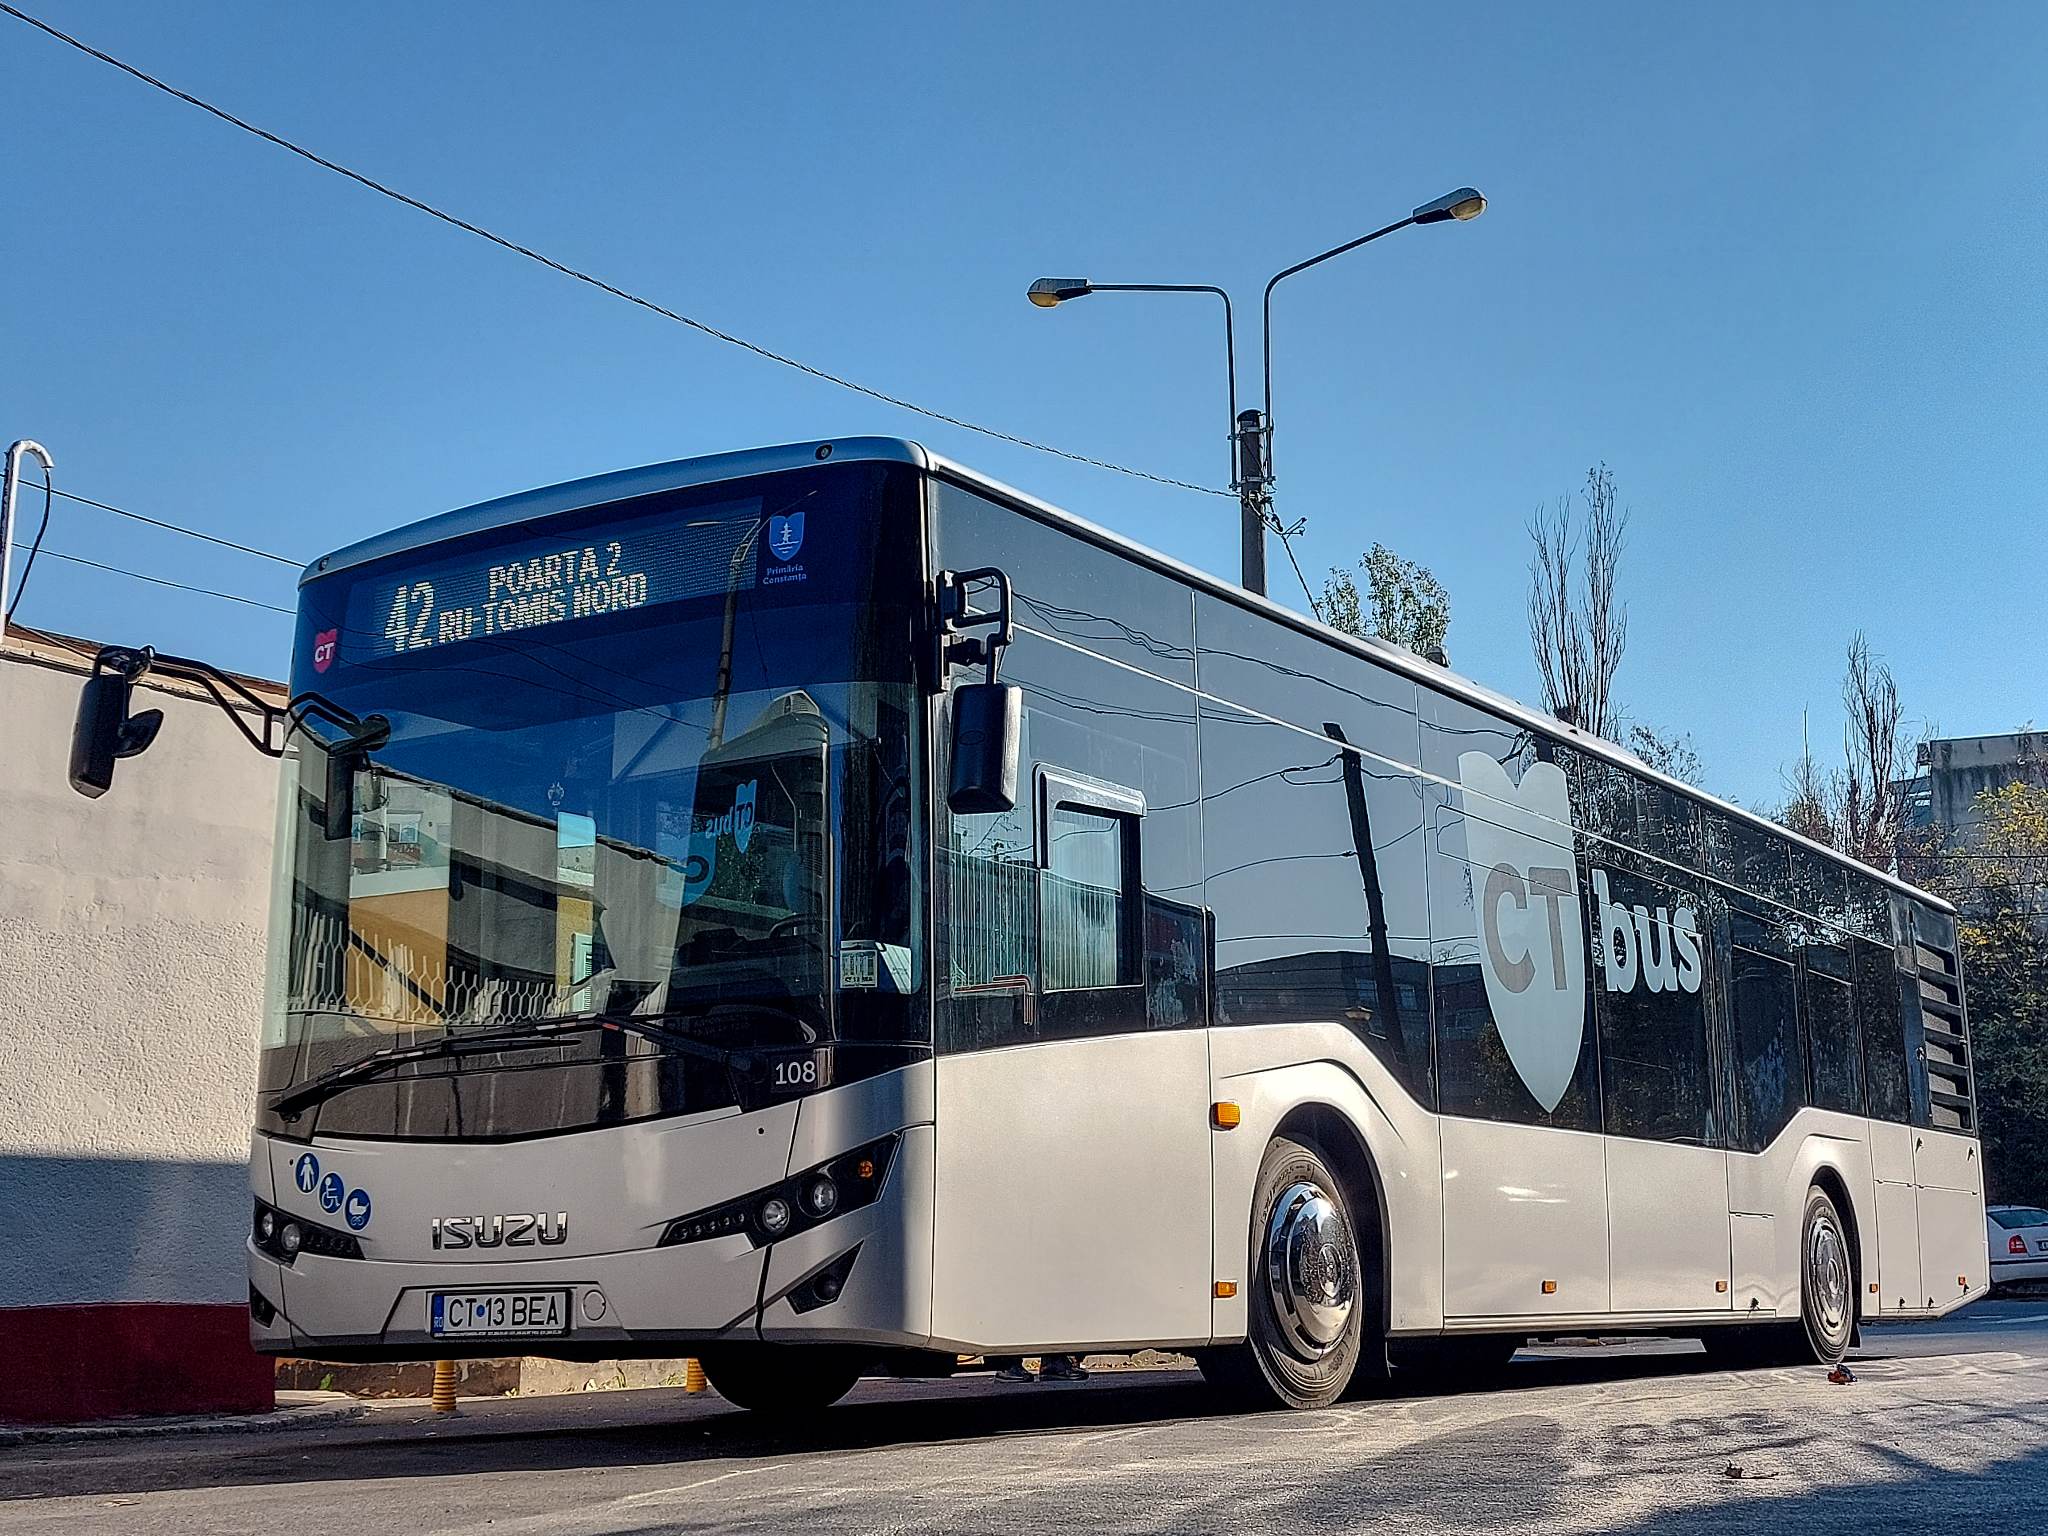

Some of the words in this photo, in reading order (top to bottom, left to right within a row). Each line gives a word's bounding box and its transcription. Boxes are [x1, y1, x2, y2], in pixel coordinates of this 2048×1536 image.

[488, 547, 599, 600] POARTA
[606, 541, 622, 576] 2
[573, 572, 648, 618] NORD
[384, 581, 433, 652] 42
[314, 642, 335, 663] CT
[1483, 861, 1572, 994] CT
[1592, 868, 1702, 993] bus
[775, 1060, 816, 1085] 108
[431, 1211, 568, 1250] ISUZU
[449, 1297, 477, 1328] CT
[485, 1297, 505, 1327] 13
[511, 1295, 559, 1327] BEA
